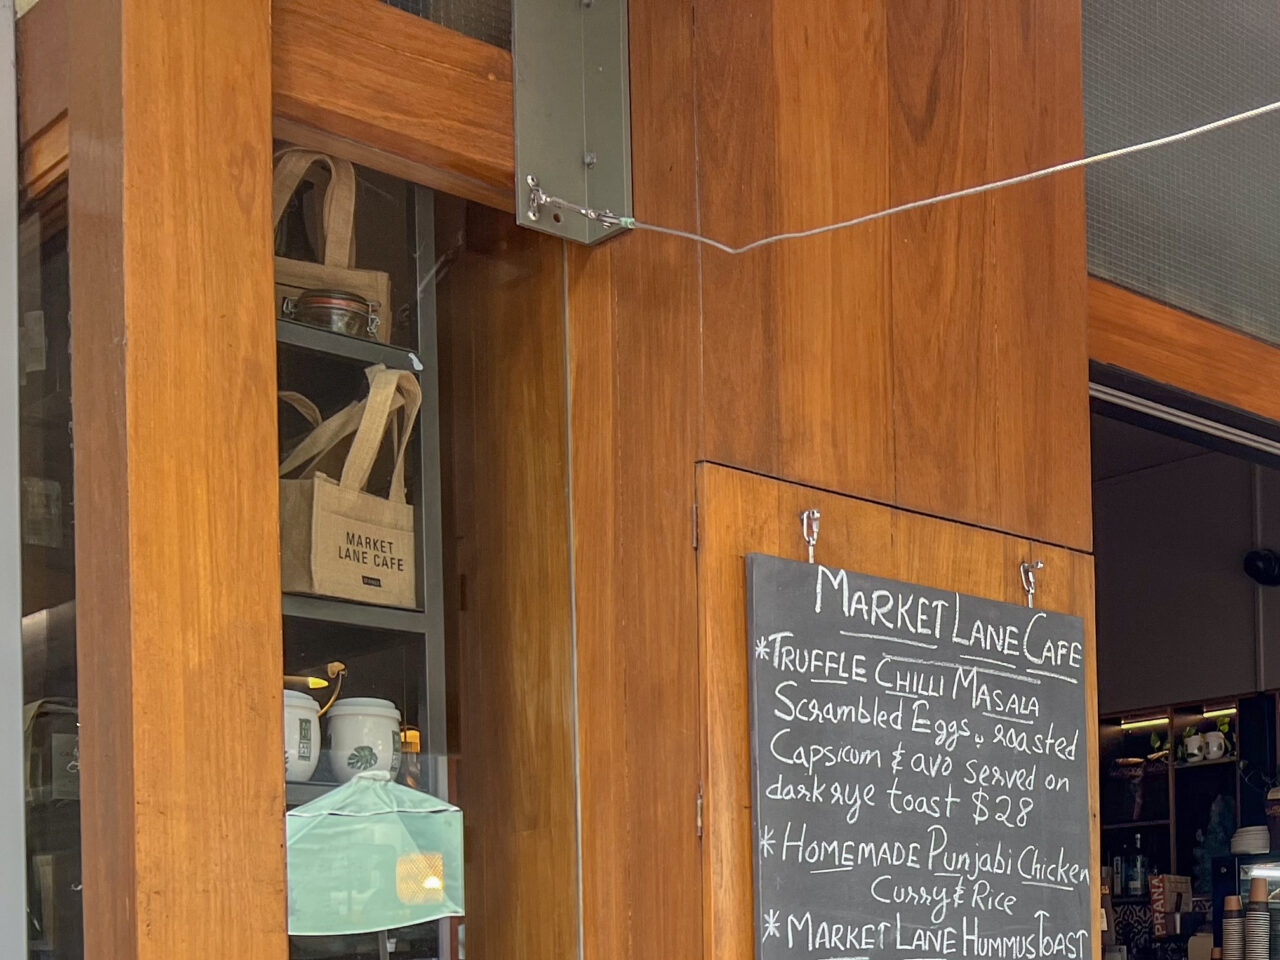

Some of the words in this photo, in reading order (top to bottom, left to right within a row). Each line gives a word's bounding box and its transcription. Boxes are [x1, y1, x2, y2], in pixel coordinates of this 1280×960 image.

[338, 545, 368, 565] LANE
[373, 554, 404, 572] CAFE
[346, 531, 394, 554] MARKET
[815, 564, 949, 639] MARKET
[952, 591, 1020, 656] LANE
[1023, 612, 1082, 668] CAFE
[875, 657, 944, 697] CHILLI
[952, 666, 1040, 717] MASALA
[774, 681, 903, 730] Scrambled
[993, 722, 1079, 761] roasted
[770, 728, 881, 776] Capsicum
[891, 741, 906, 774] &
[911, 754, 952, 778] avo
[963, 759, 1037, 791] served
[1045, 774, 1069, 792] on
[766, 774, 826, 802] dark
[830, 782, 876, 824] rye
[886, 777, 960, 818] toast
[971, 787, 1034, 827] $28
[782, 822, 920, 868] HOMEMADE
[927, 825, 1012, 880] Punjabi
[1017, 845, 1090, 886] Chicken
[871, 875, 950, 923] Curry
[953, 876, 966, 908] &
[972, 880, 1017, 915] Rice
[787, 911, 891, 951] MARKET
[896, 912, 957, 954] LANE
[962, 916, 1036, 960] HUMMUS
